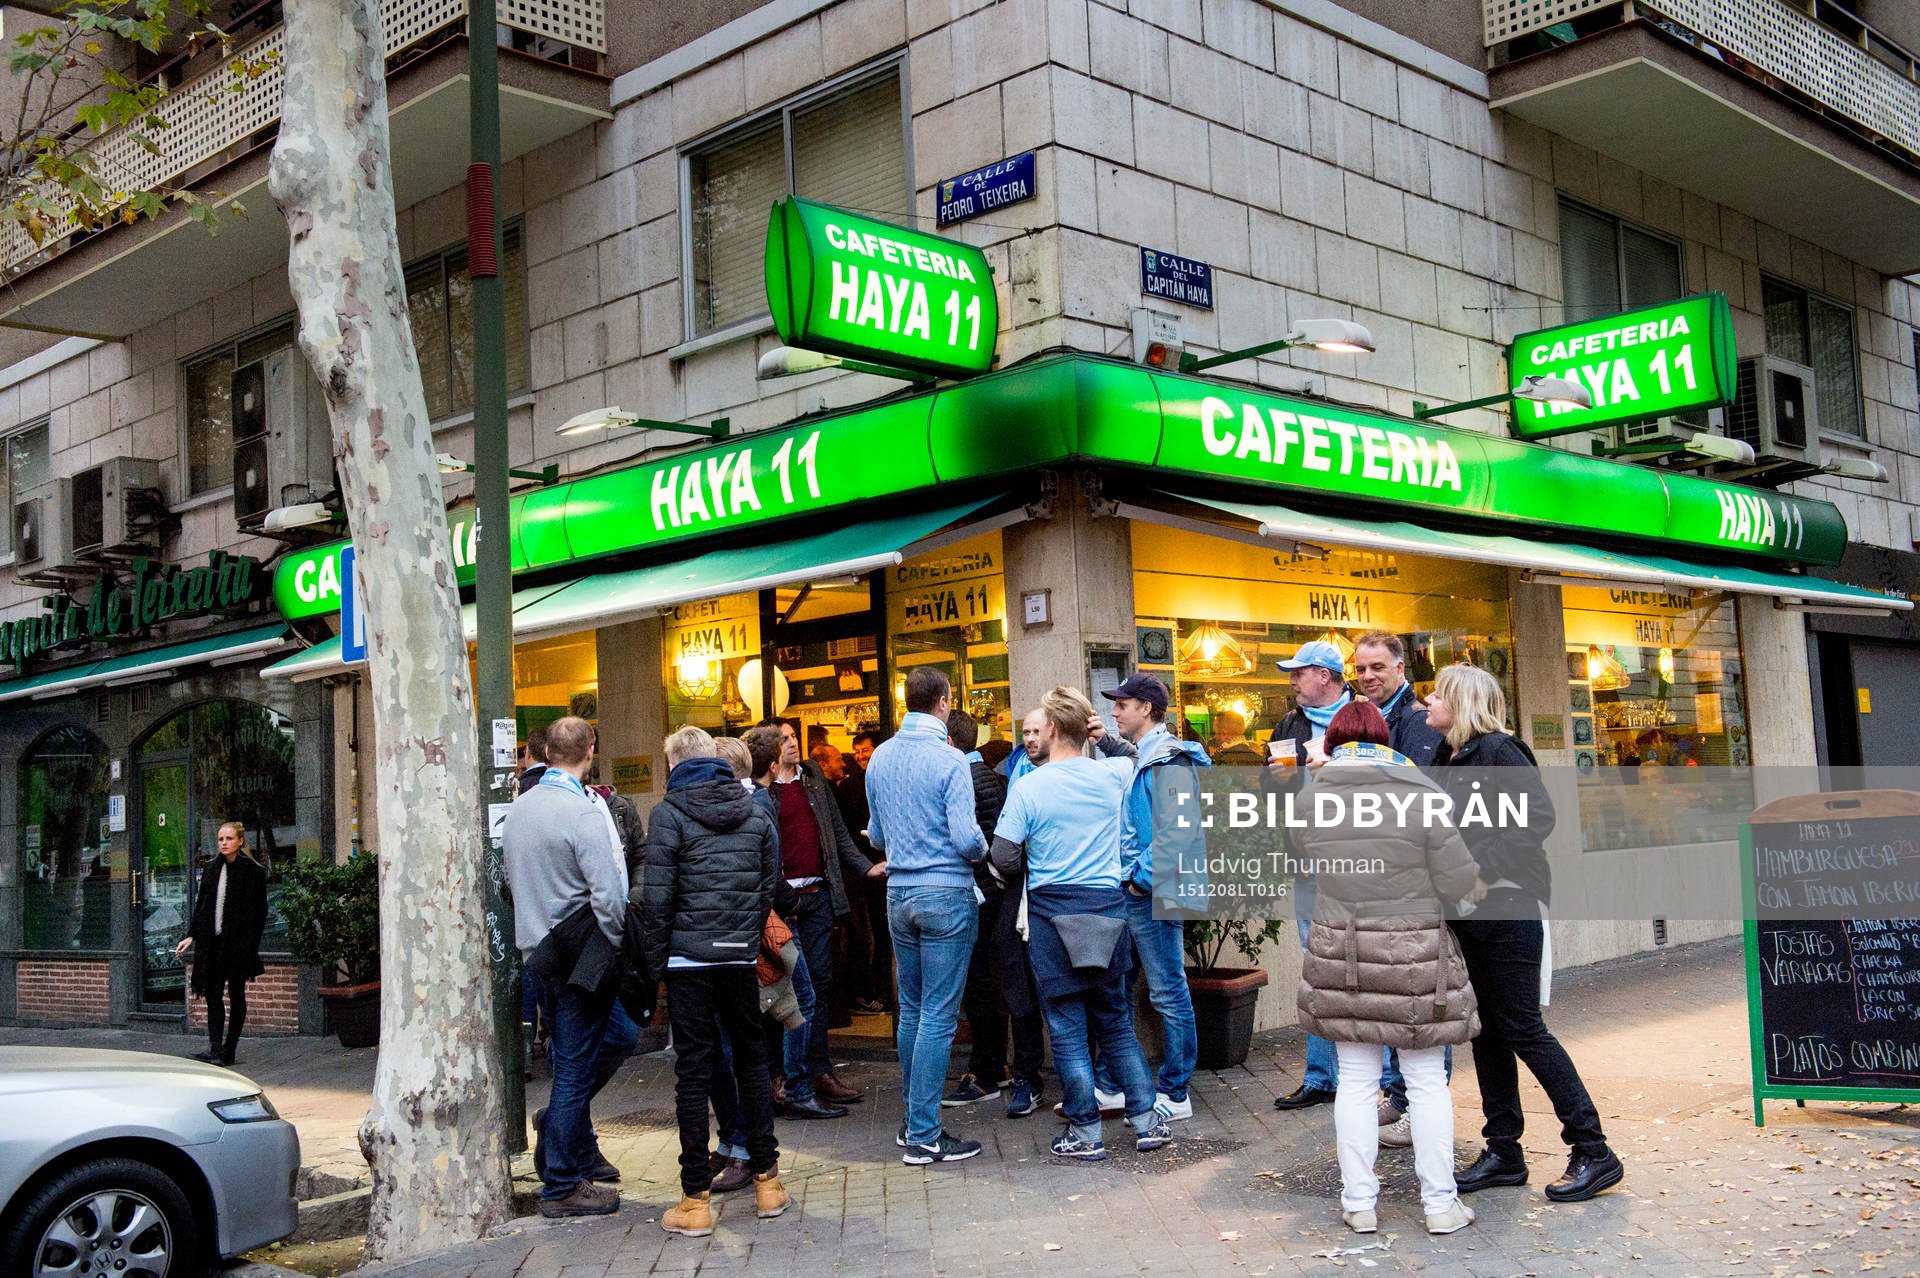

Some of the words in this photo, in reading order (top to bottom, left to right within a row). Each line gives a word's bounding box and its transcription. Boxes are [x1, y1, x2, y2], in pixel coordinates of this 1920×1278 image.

[962, 160, 1016, 187] CALLE
[974, 181, 987, 191] DE
[941, 197, 974, 222] PEDRO
[979, 180, 1027, 209] TEIXEIRA
[825, 224, 977, 284] CAFETERIA
[1160, 256, 1204, 277] CALLE
[1147, 274, 1185, 299] CAPITÁN
[1187, 284, 1208, 305] HAYA
[1173, 271, 1188, 281] DEL
[829, 261, 930, 340] HAYA
[945, 290, 980, 350] 11
[1530, 315, 1690, 366] CAFETERIA
[1650, 344, 1696, 395] 11
[1200, 396, 1462, 491] CAFETERIA
[651, 449, 762, 531] HAYA
[772, 431, 821, 504] 11
[1715, 489, 1775, 546] HAYA
[1781, 501, 1803, 550] 11
[87, 573, 122, 637] de
[132, 549, 252, 629] Teixeira
[904, 591, 959, 626] HAYA
[966, 584, 987, 616] 11
[1310, 592, 1350, 621] HAYA
[1354, 595, 1370, 623] 11
[681, 628, 724, 658] HAYA
[729, 623, 746, 651] 11
[1635, 619, 1662, 643] HAYA
[1800, 823, 1830, 839] HAYA
[1837, 821, 1856, 838] 11
[1755, 844, 1898, 878] HAMBURGUESA
[1758, 883, 1791, 908] CON
[1794, 878, 1858, 907] JAMON
[1763, 931, 1835, 956] TOSTAS
[1761, 954, 1851, 986] VARIADAS
[1772, 1033, 1843, 1078] PLATOS
